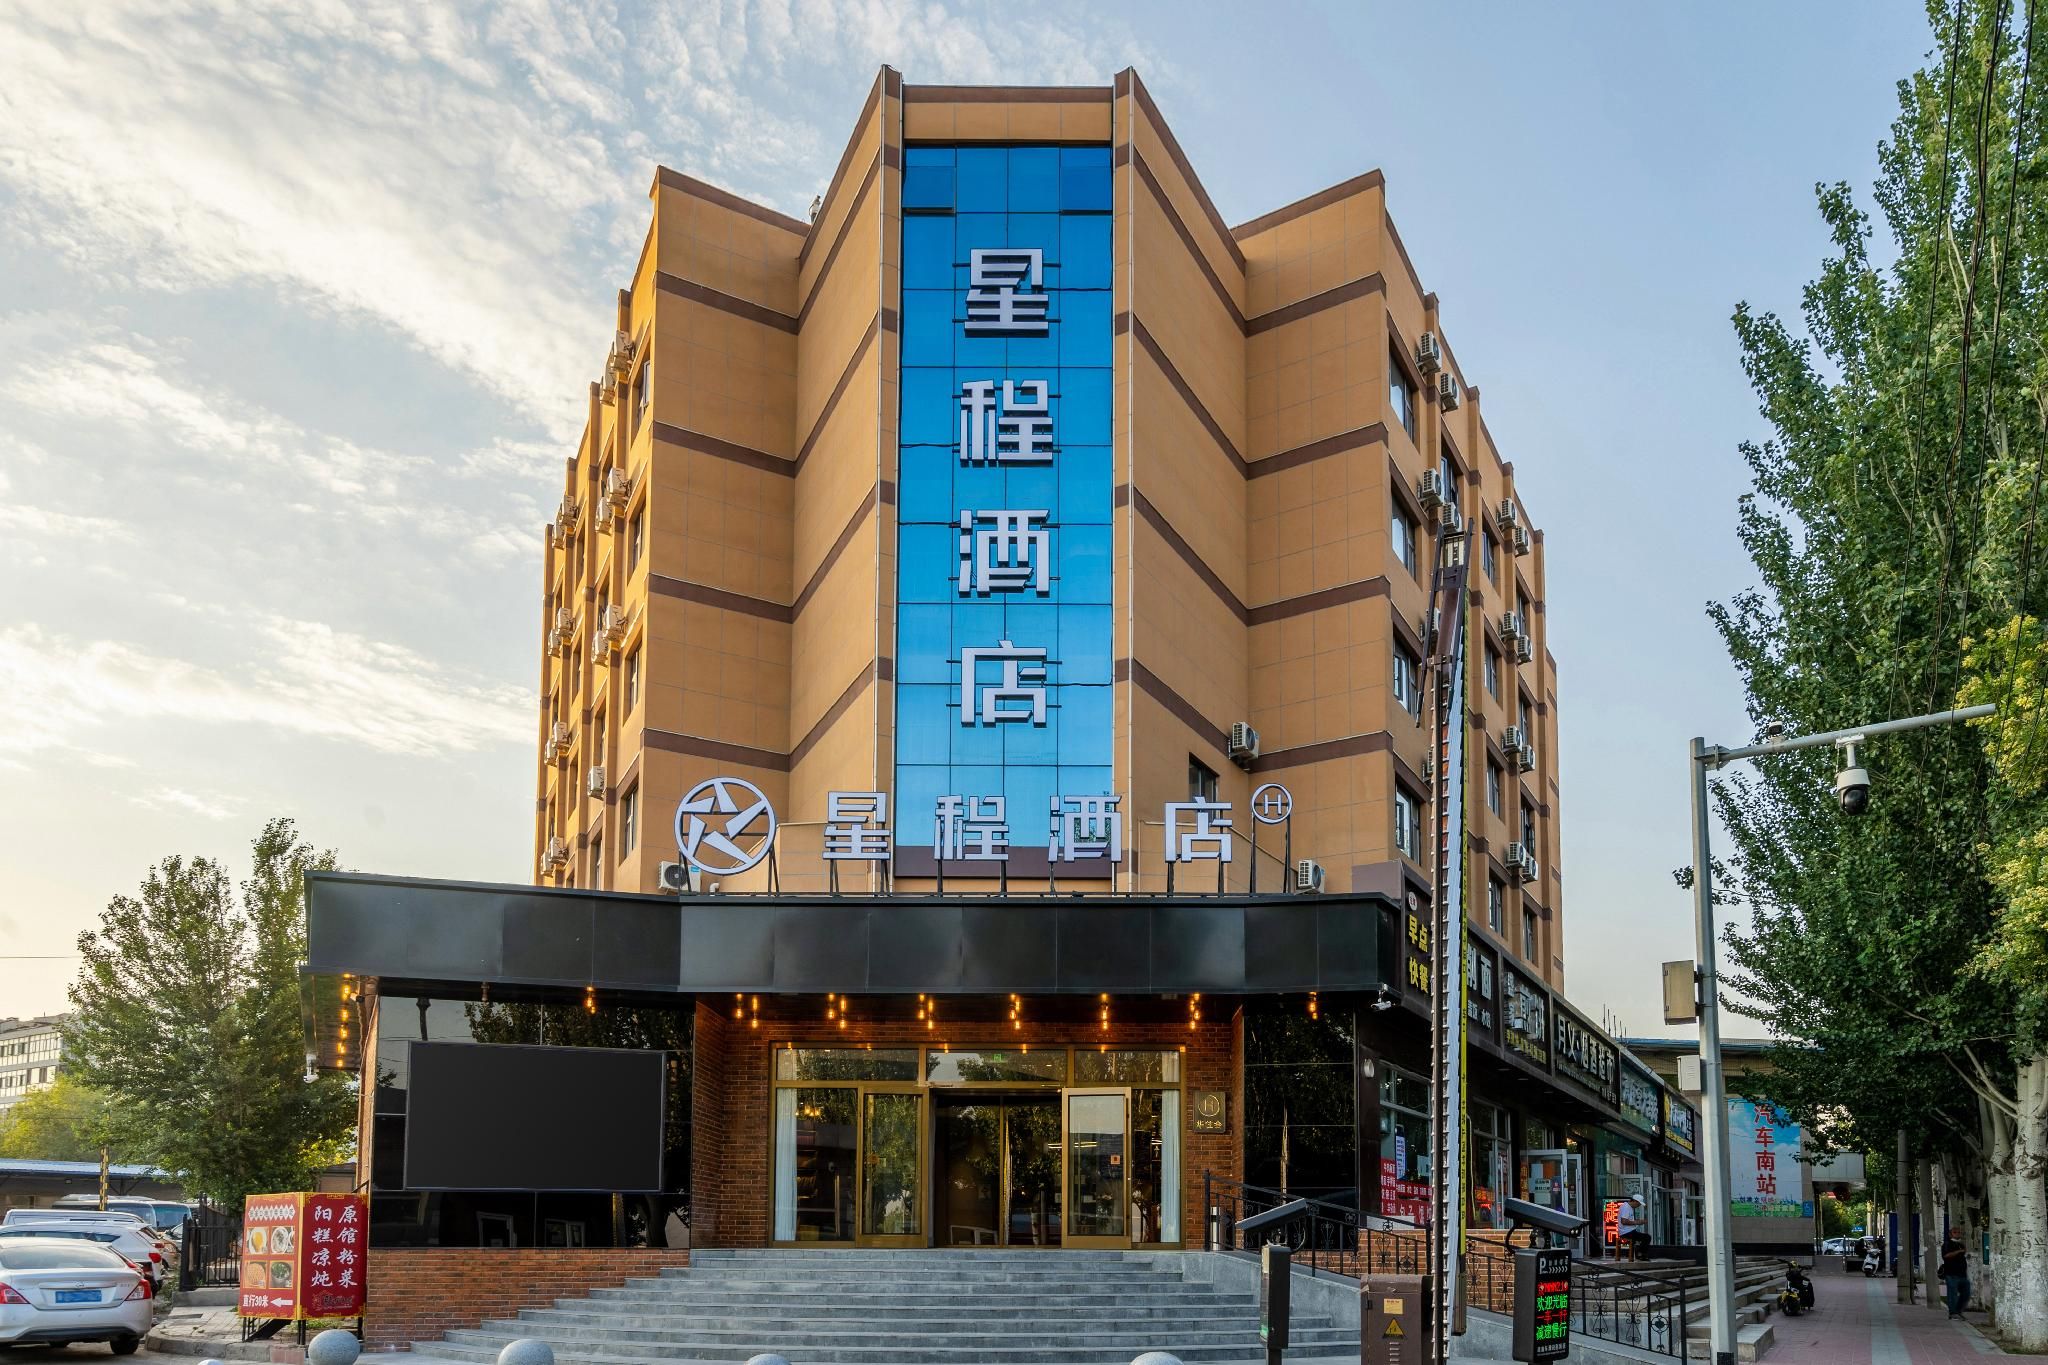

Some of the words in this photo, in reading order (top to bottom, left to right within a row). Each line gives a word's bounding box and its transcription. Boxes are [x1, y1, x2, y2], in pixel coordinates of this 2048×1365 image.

[959, 247, 1054, 729] 星程酒店
[822, 791, 1233, 863] 星程酒店
[1408, 914, 1428, 953] 早点
[1409, 956, 1429, 994] 快餐
[1753, 1104, 1777, 1196] 汽车南站
[1536, 1294, 1569, 1312] 欢迎光临
[1535, 1322, 1568, 1341] 减速慢行
